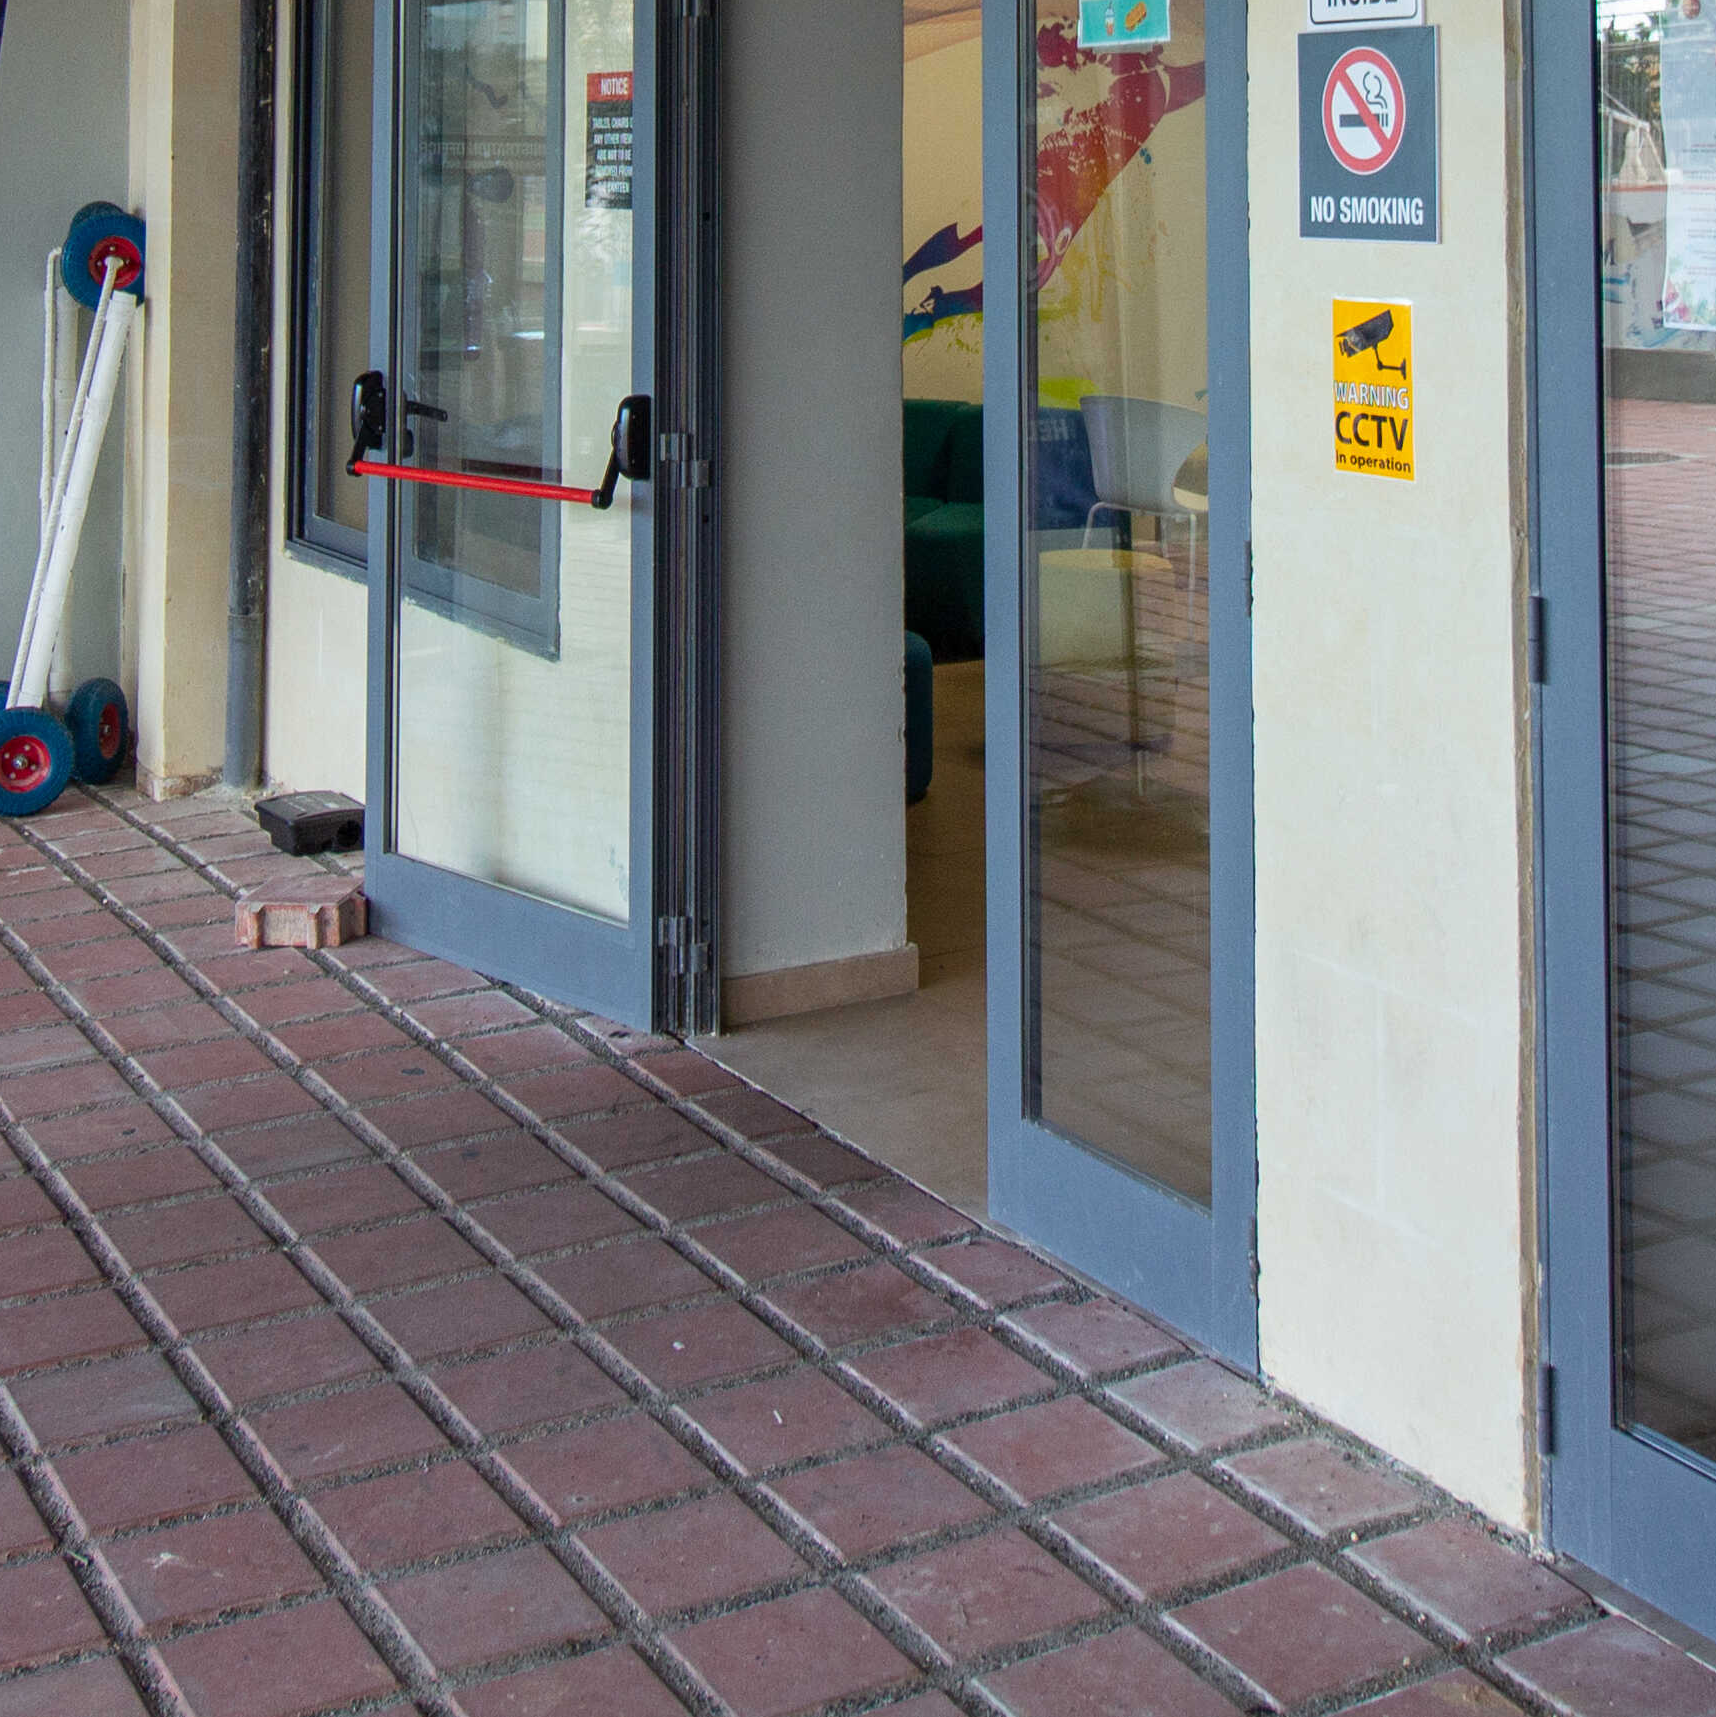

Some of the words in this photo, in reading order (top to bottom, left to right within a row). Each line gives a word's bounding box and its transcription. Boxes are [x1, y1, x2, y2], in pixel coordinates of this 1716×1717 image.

[600, 77, 629, 96] NOTICE
[1310, 196, 1335, 223] NO
[1339, 196, 1424, 226] SMOKING
[1333, 381, 1410, 410] WARNING
[1335, 411, 1409, 452] CCTV
[1350, 454, 1411, 473] operation
